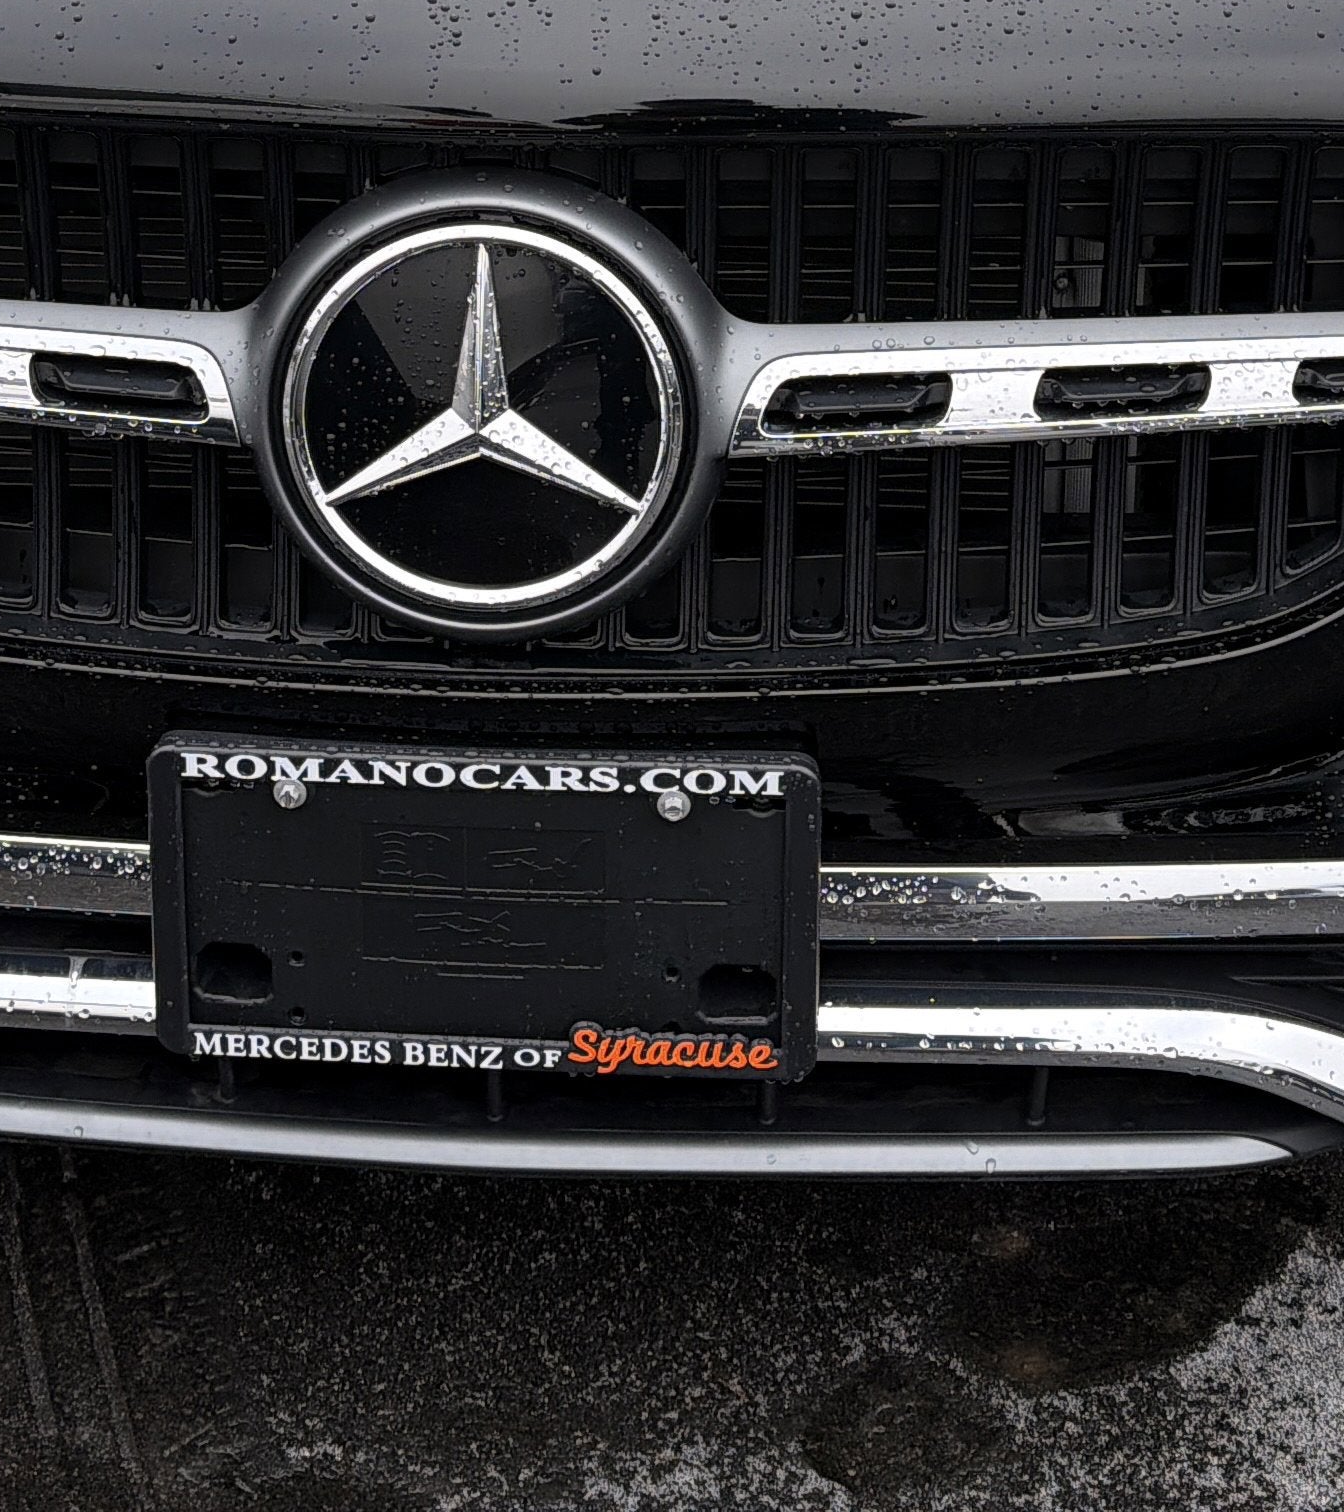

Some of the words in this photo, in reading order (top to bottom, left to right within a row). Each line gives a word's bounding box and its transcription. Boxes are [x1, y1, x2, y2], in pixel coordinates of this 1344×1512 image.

[180, 751, 785, 797] ROMANOCARS.COM
[193, 1032, 393, 1065] MERCEDES
[402, 1041, 504, 1070] BENZ
[513, 1048, 562, 1069] OF
[568, 1029, 779, 1074] Syracuse
